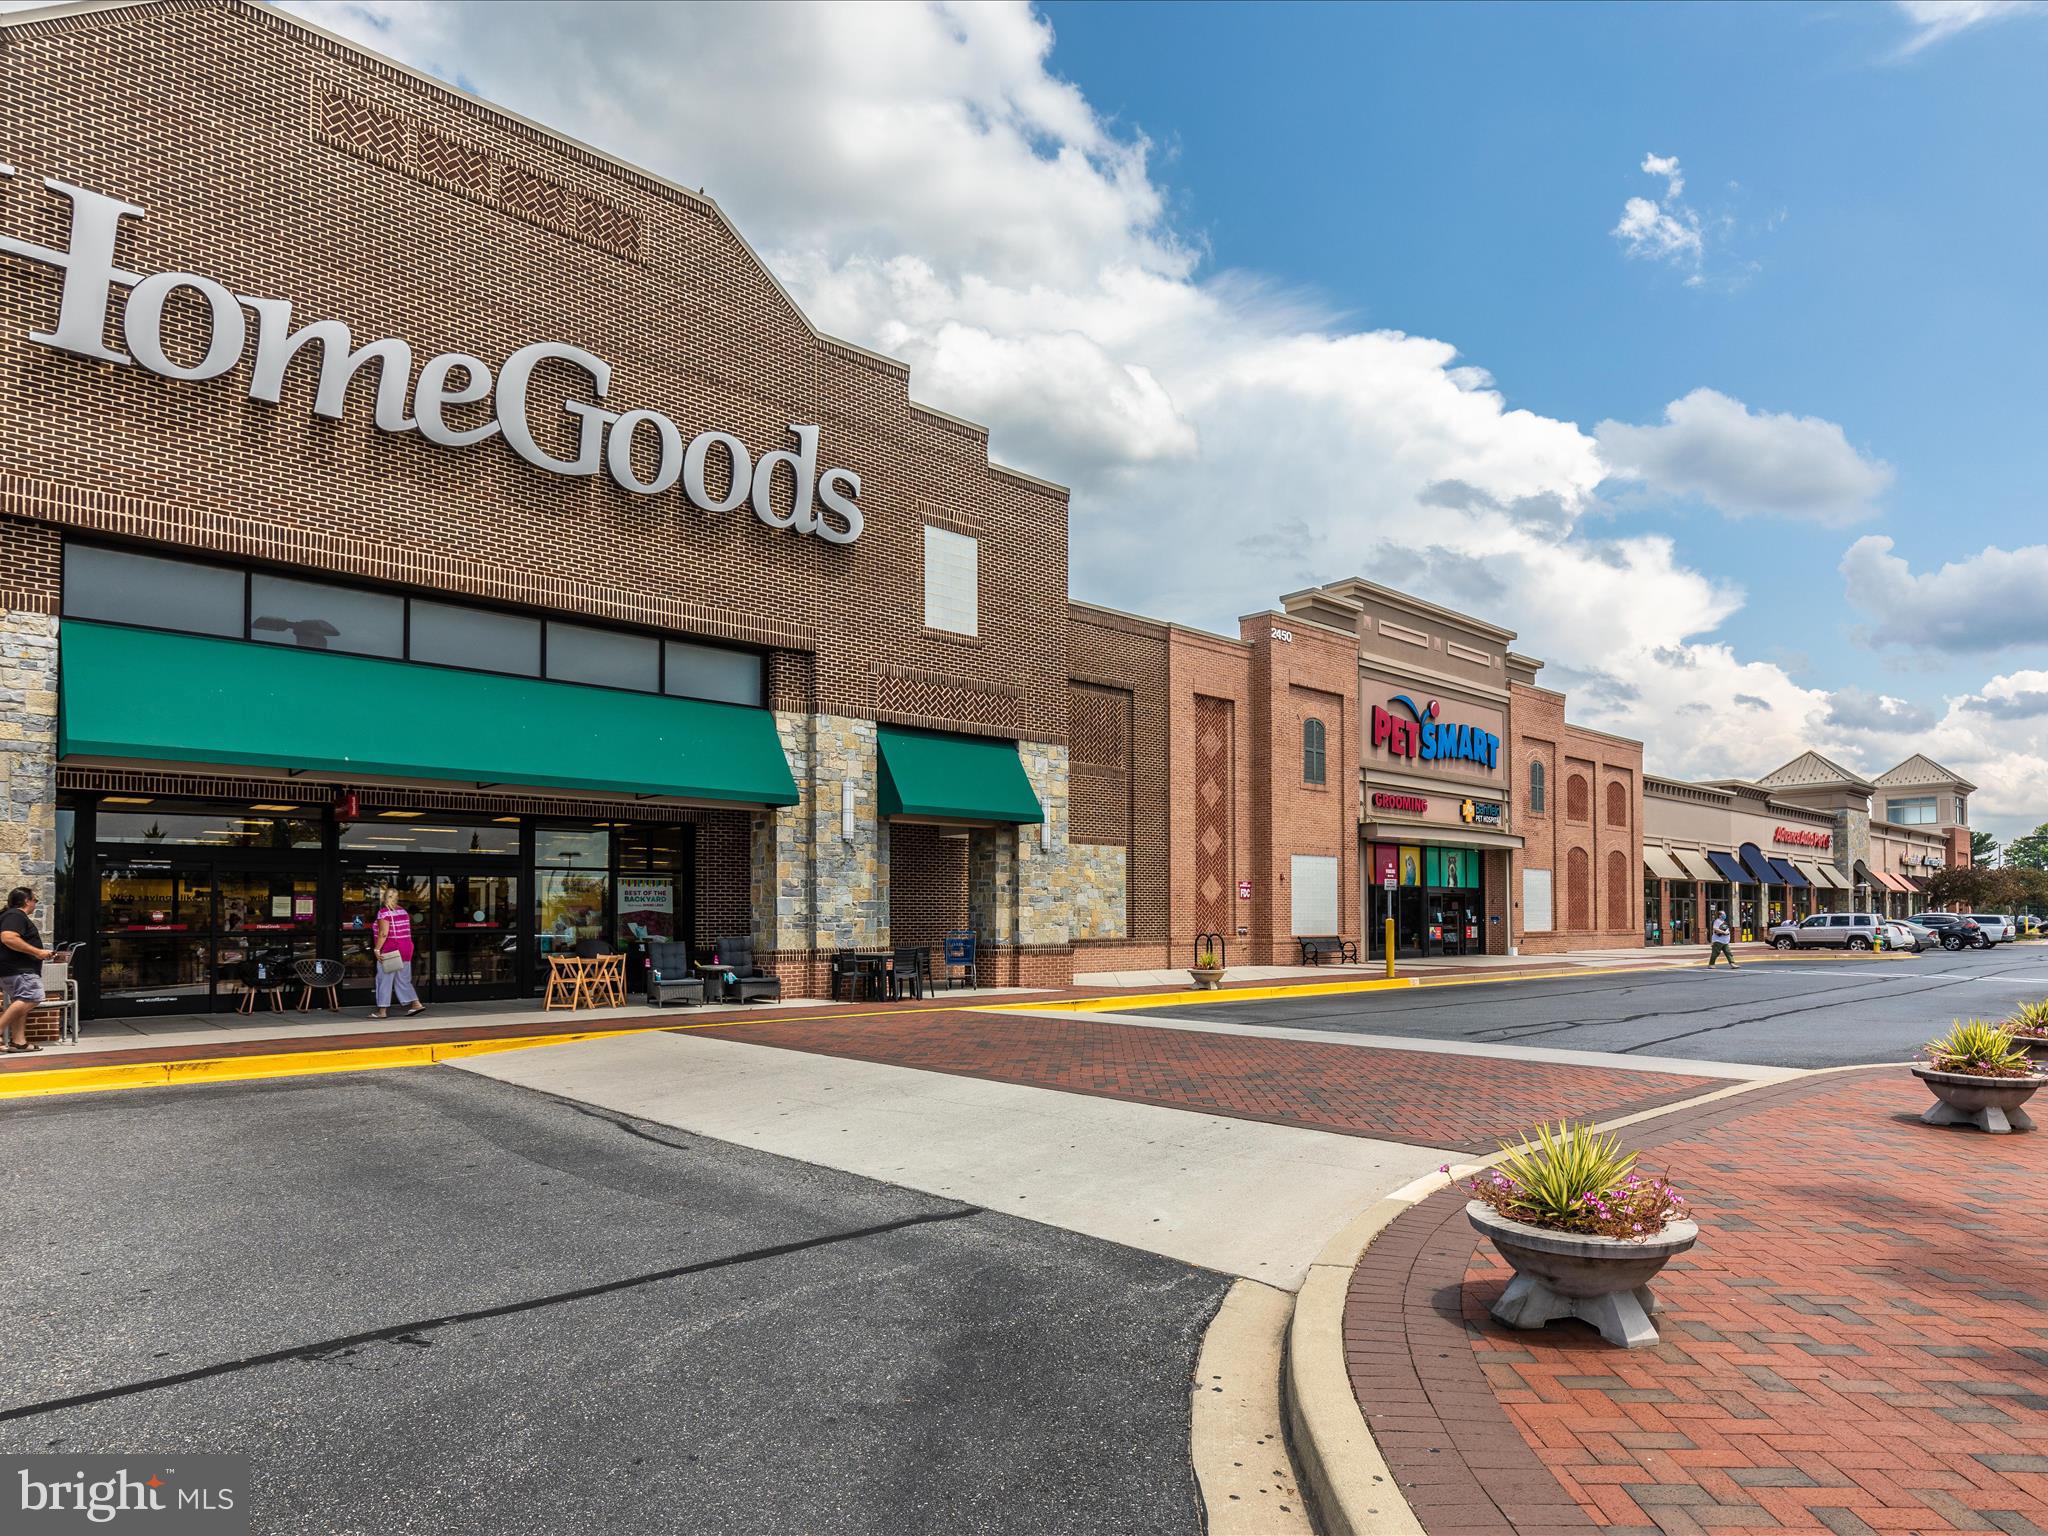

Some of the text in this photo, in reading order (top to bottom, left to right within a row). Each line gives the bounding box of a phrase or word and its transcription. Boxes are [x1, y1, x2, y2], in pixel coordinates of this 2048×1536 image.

[0, 162, 866, 546] HomeGoods
[1271, 628, 1292, 642] 2450
[1372, 704, 1500, 770] PETSMART
[1372, 792, 1429, 813] GROOMING
